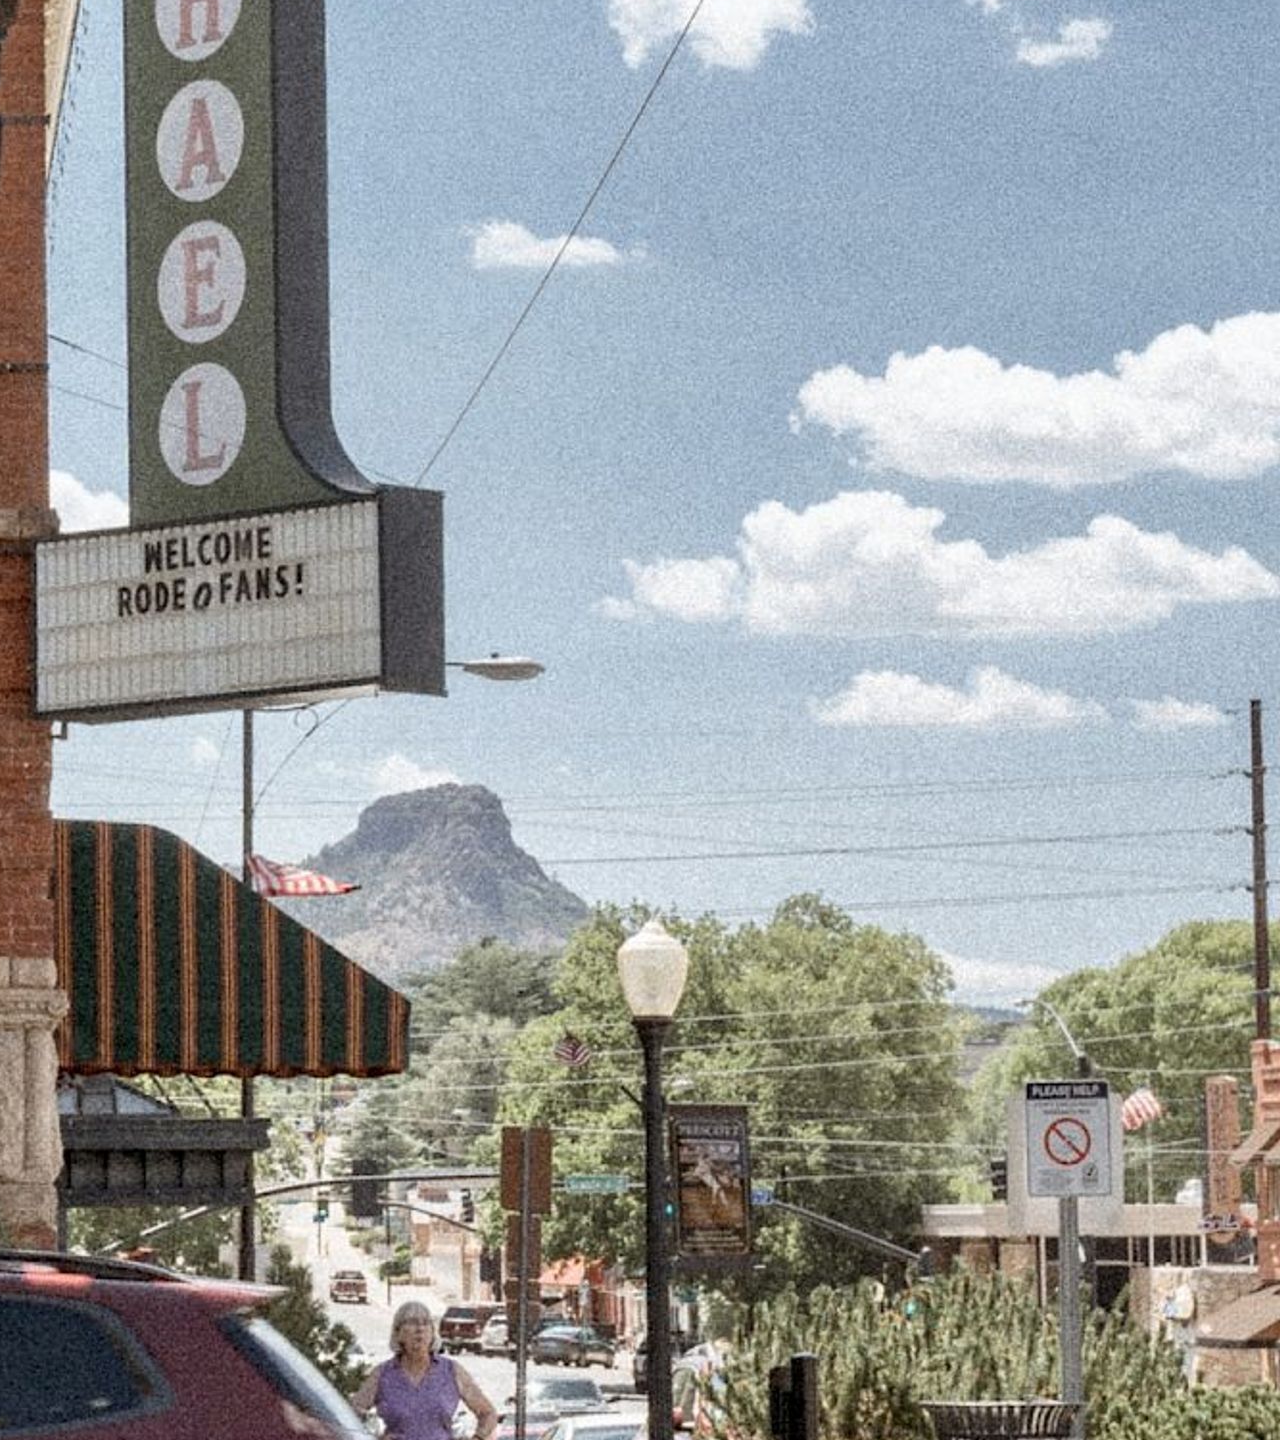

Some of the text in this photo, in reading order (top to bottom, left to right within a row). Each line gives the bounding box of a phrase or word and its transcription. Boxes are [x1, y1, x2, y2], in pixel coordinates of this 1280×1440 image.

[143, 526, 272, 573] WELCOME
[118, 563, 305, 617] RODEO FANS!
[1031, 1084, 1099, 1097] PLEASE HELP
